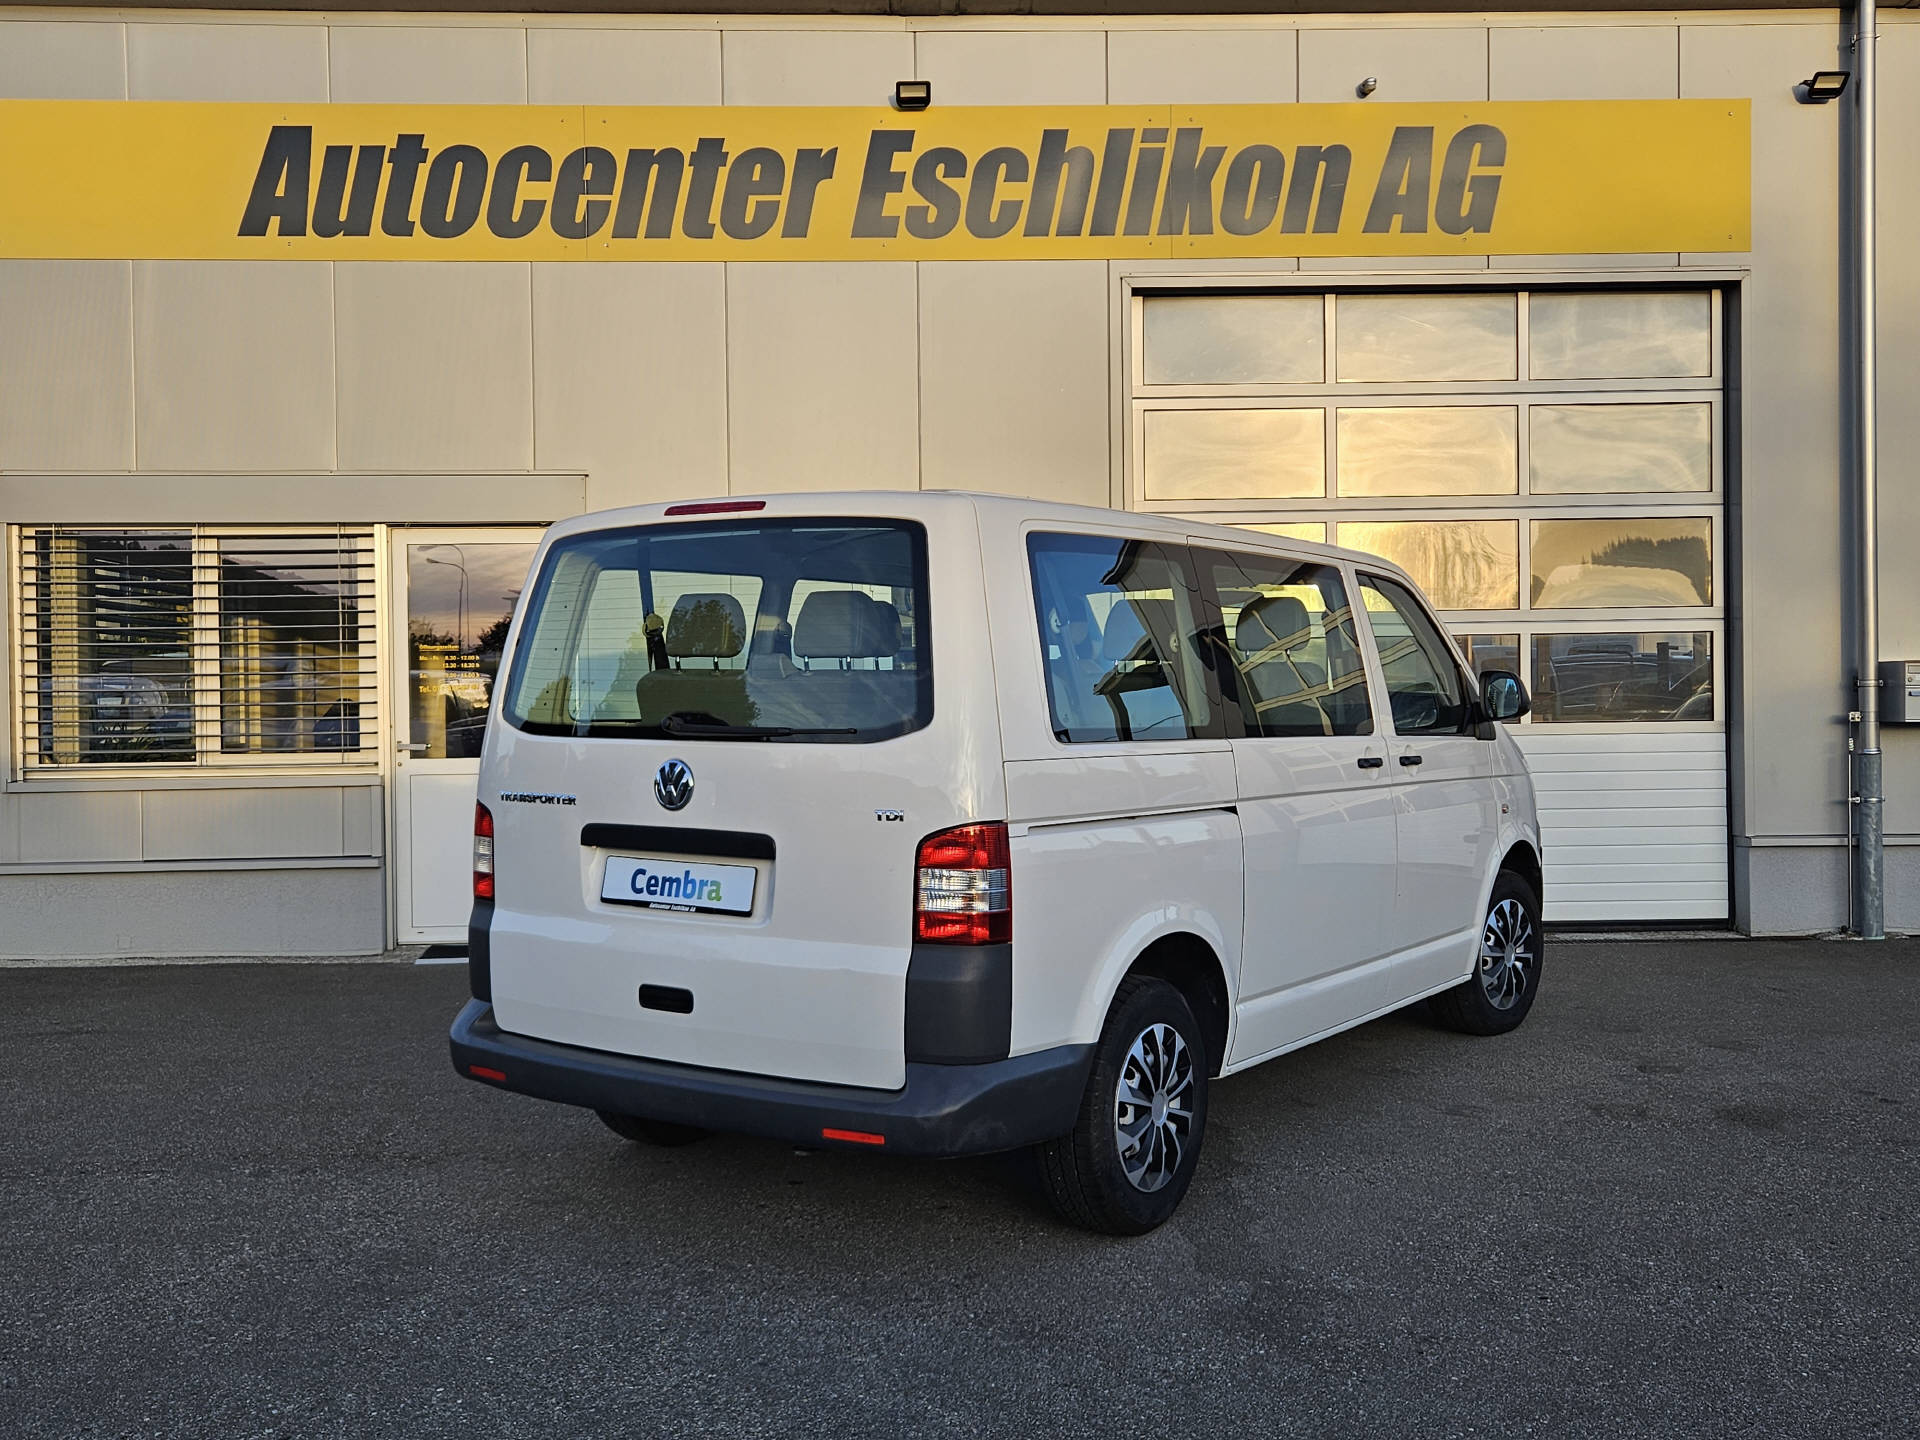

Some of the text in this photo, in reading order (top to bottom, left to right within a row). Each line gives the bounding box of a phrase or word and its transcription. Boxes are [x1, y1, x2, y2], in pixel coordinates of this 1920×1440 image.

[237, 124, 1507, 239] Autocenter Eschlikon AG
[499, 790, 577, 805] TRANSPORTER
[655, 759, 694, 811] VW
[630, 868, 722, 901] Cembra
